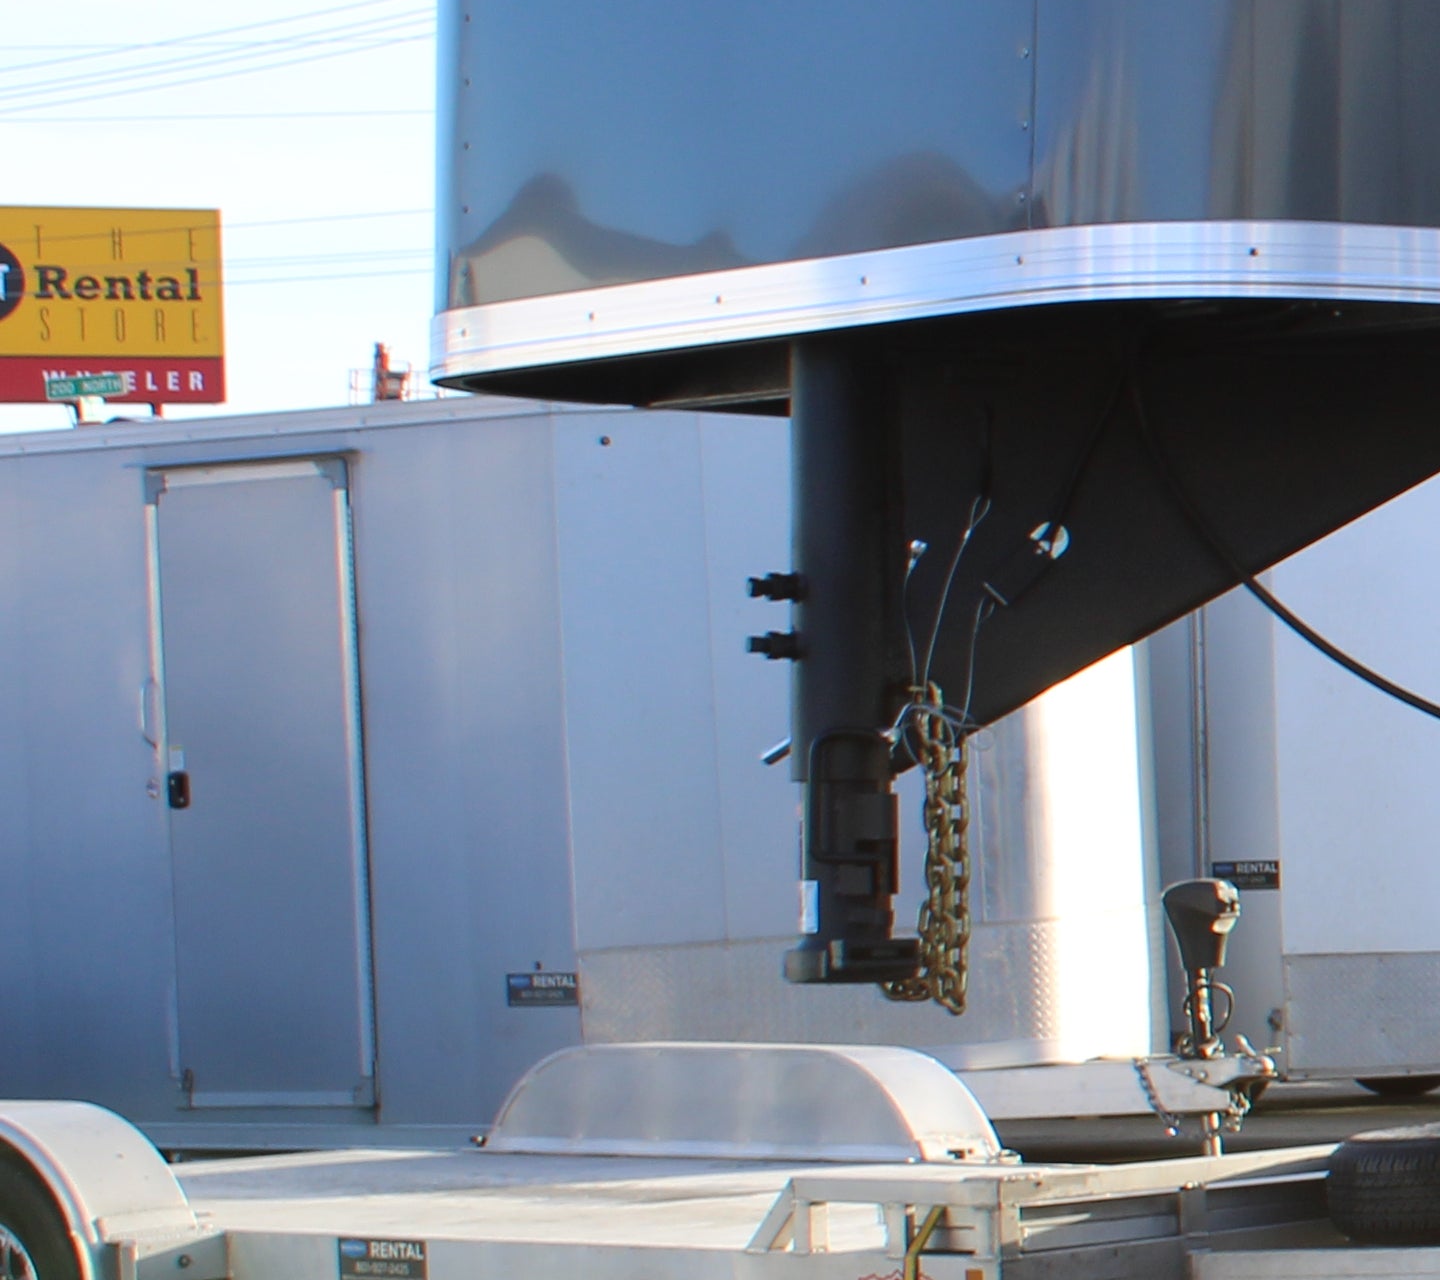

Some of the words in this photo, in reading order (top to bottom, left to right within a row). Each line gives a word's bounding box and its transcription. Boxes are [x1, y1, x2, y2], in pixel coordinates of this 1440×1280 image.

[35, 224, 197, 263] THE
[34, 265, 203, 302] Rental
[40, 307, 203, 343] STORE
[82, 378, 123, 393] NORTH
[1236, 863, 1277, 873] RENTAL
[532, 975, 576, 988] RENTAL
[370, 1241, 424, 1260] RENTAL
